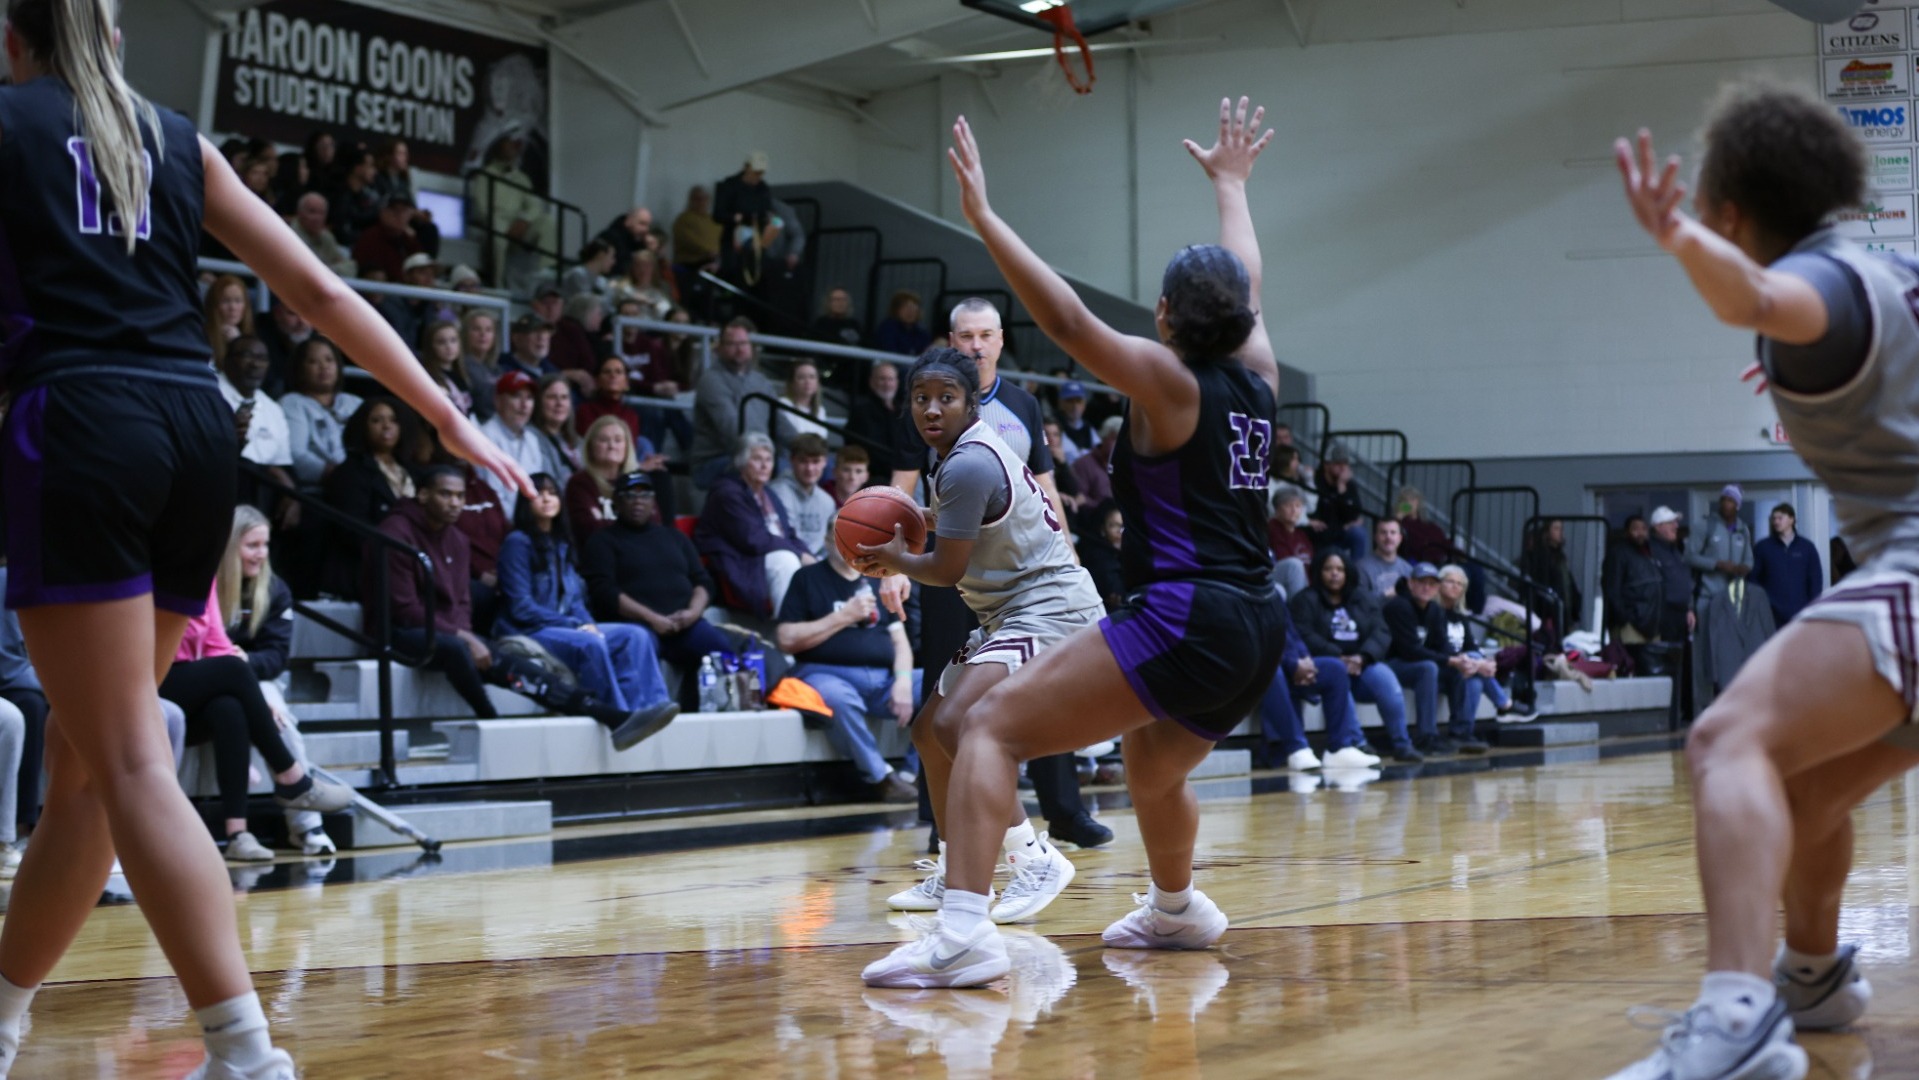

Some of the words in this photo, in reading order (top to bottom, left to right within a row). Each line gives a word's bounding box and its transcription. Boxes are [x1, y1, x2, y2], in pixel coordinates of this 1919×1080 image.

[1829, 33, 1900, 48] CITIZENS
[366, 36, 475, 109] GOONS
[233, 64, 352, 126] STUDENT
[354, 91, 456, 147] SECTION
[1864, 126, 1905, 138] energy
[1875, 155, 1909, 167] Jones
[1228, 411, 1271, 490] 23
